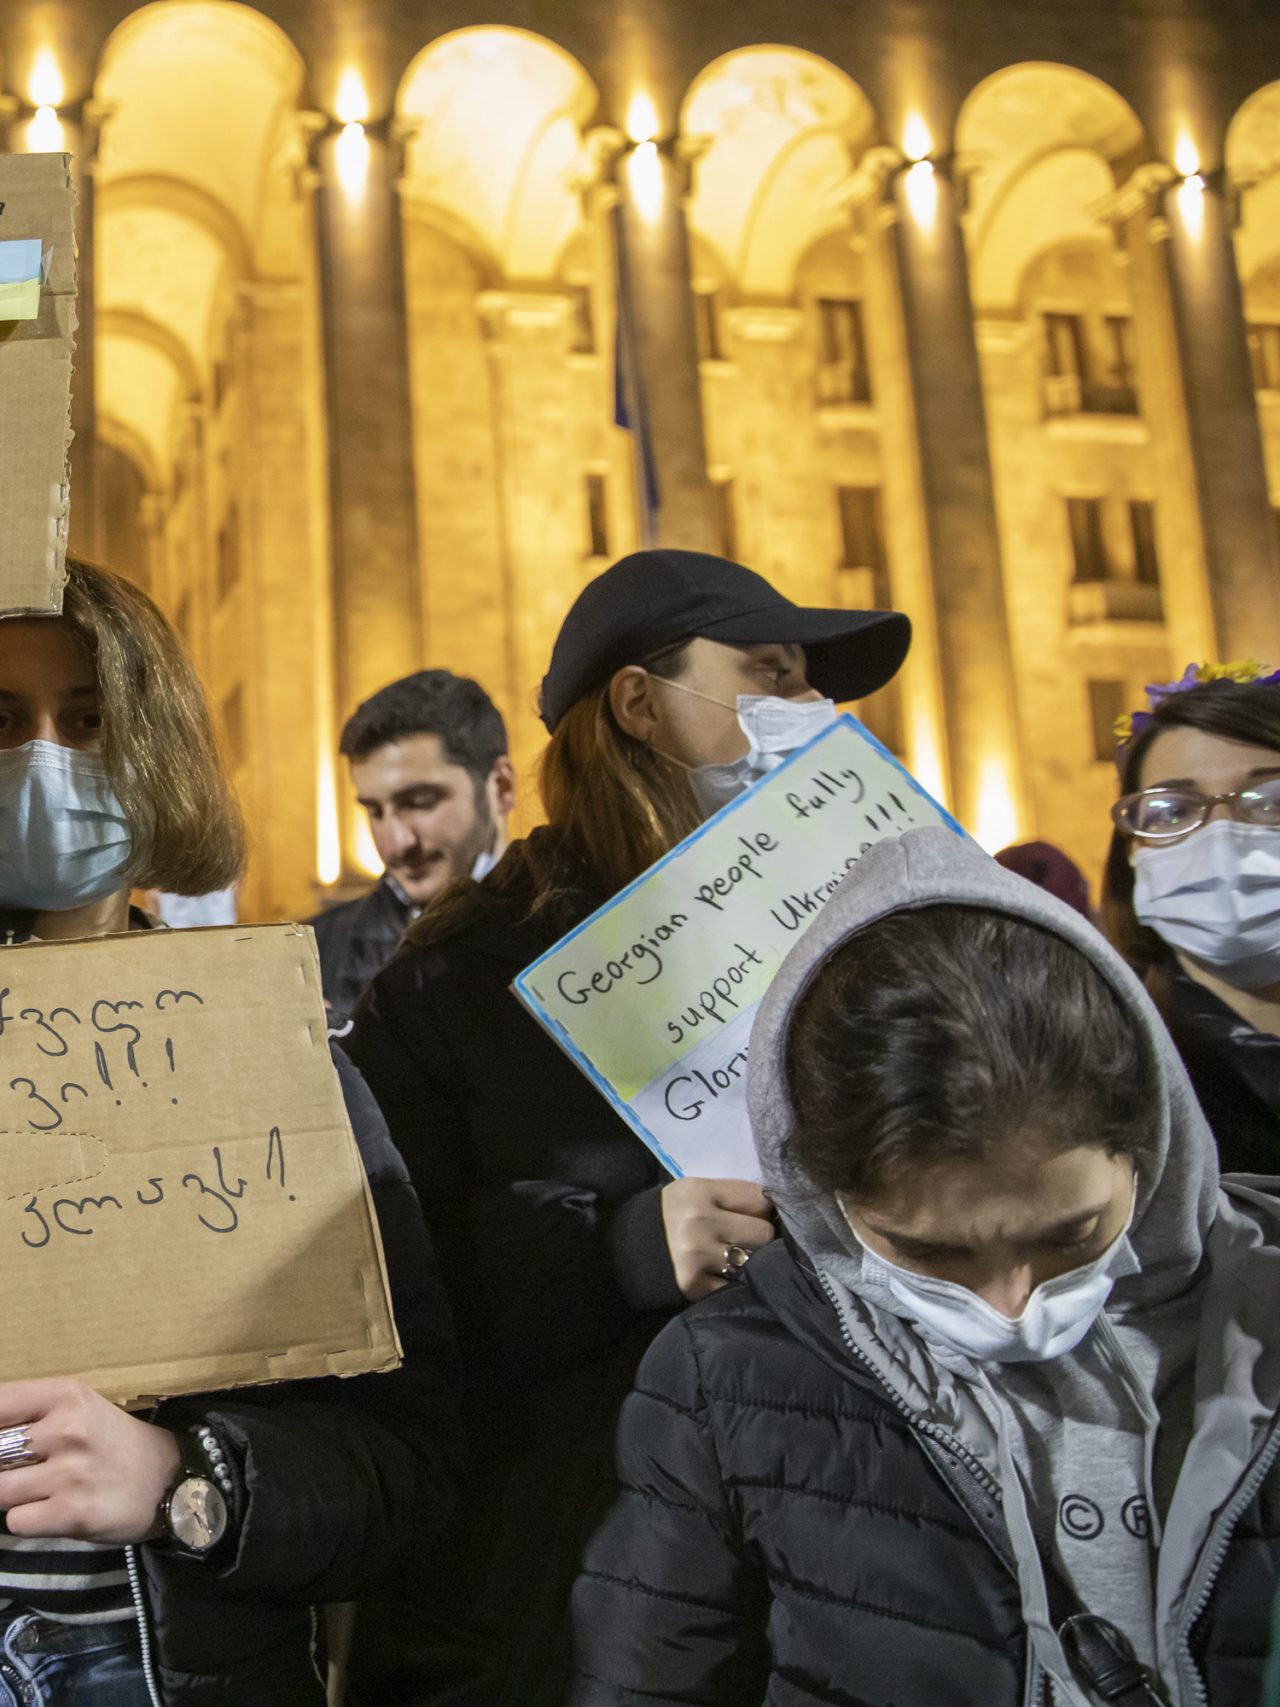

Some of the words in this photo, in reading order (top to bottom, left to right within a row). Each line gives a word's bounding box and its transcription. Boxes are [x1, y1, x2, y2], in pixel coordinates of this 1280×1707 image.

[556, 911, 689, 1005] Georgian
[693, 831, 781, 912] people
[784, 768, 867, 820] fully
[666, 942, 764, 1044] support
[664, 1046, 749, 1121] Glor
